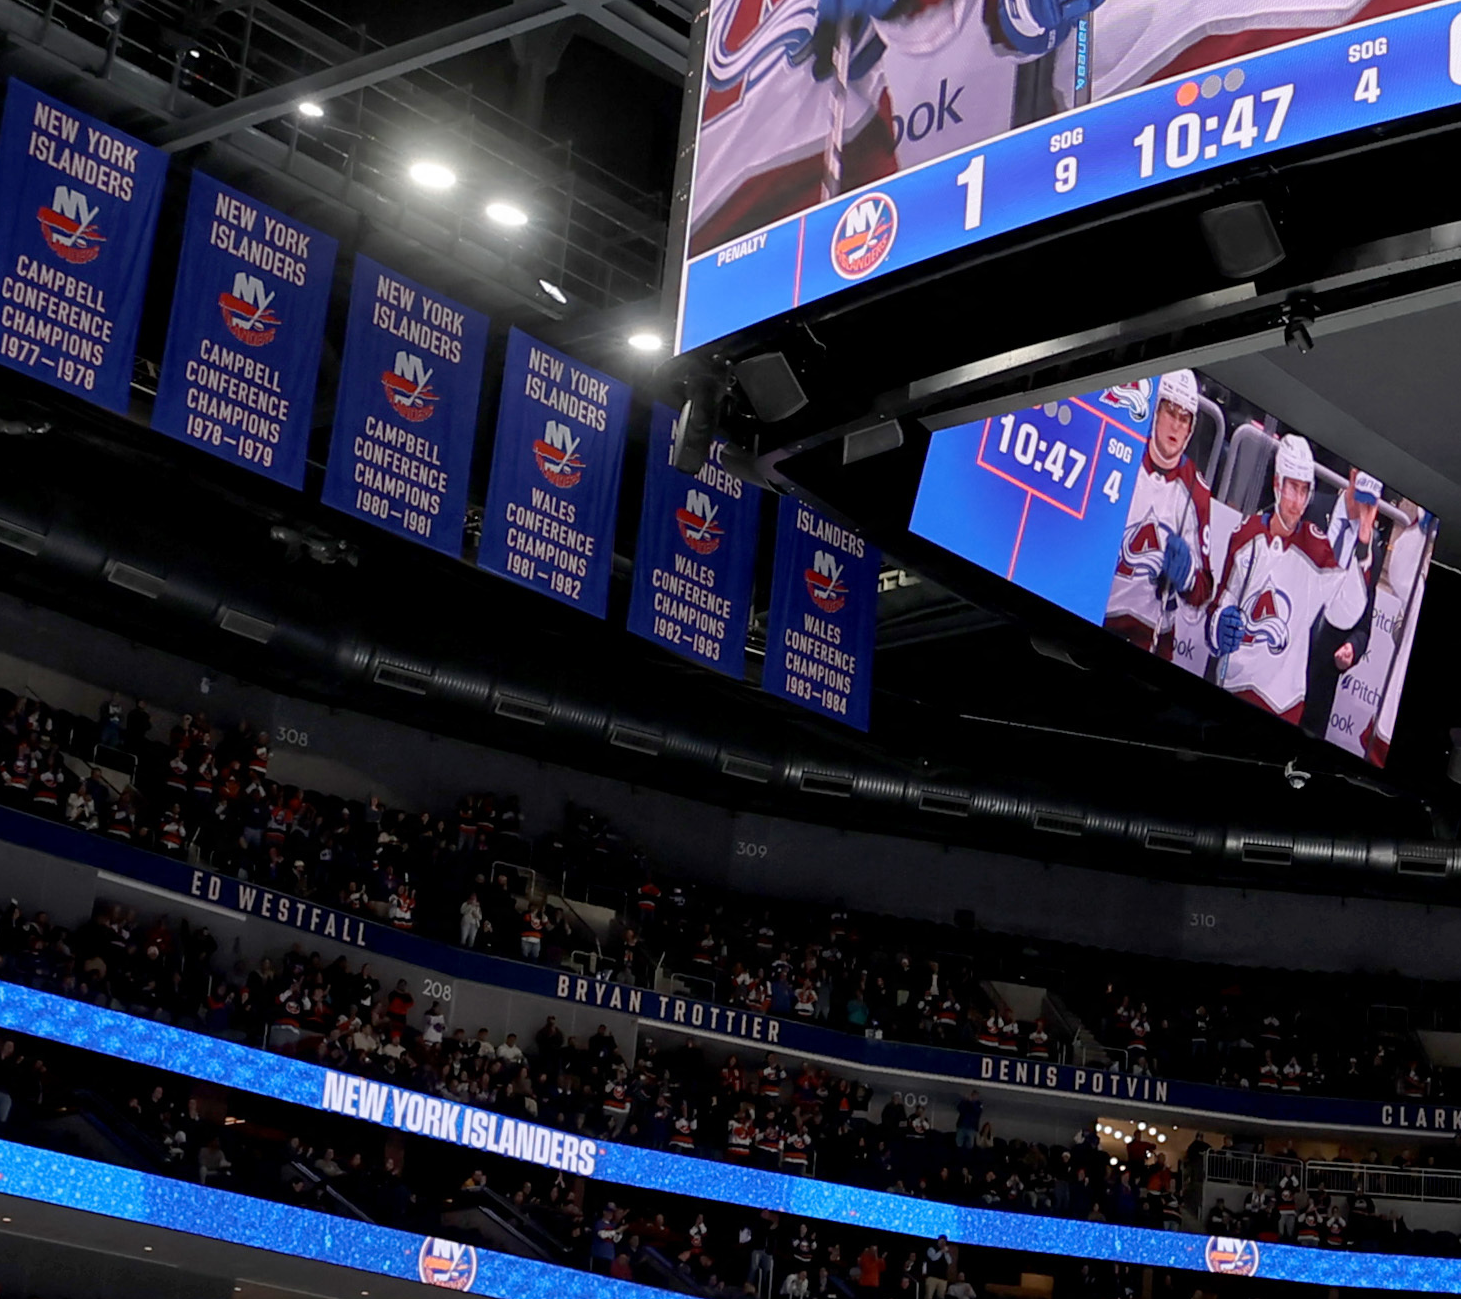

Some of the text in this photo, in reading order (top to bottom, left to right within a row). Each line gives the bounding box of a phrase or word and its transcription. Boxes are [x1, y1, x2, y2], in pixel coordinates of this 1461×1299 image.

[1348, 37, 1388, 64] SOG
[1354, 66, 1381, 104] 4
[33, 102, 138, 174] NEW YORK
[1049, 127, 1083, 153] SOG
[1133, 84, 1295, 178] 10:47
[28, 132, 134, 203] ISLANDERS
[956, 155, 985, 229] 1
[1055, 156, 1077, 192] 9
[716, 233, 768, 267] PENALTY
[0, 276, 114, 343] CONFERENCE
[14, 254, 108, 313] CAMPBELL
[0, 305, 105, 367] CHAMPIONS
[525, 373, 607, 433] ISLANDERS
[528, 347, 609, 407] NEW YORK
[999, 413, 1087, 491] 10:47
[1107, 437, 1132, 464] SOG
[530, 487, 575, 524] WALES
[1103, 470, 1122, 504] 4
[506, 501, 593, 557] CONFERENCE
[507, 526, 586, 578] CHAMPIONS
[276, 726, 309, 747] 308
[736, 842, 768, 858] 309
[191, 870, 368, 948] ED WESTFALL
[1189, 913, 1216, 928] 310
[422, 978, 452, 1000] 208
[556, 973, 781, 1044] BRYAN TROTTIER
[979, 1057, 1168, 1101] DENIS POTVIN
[322, 1069, 597, 1178] NEW YORK ISLANDERS
